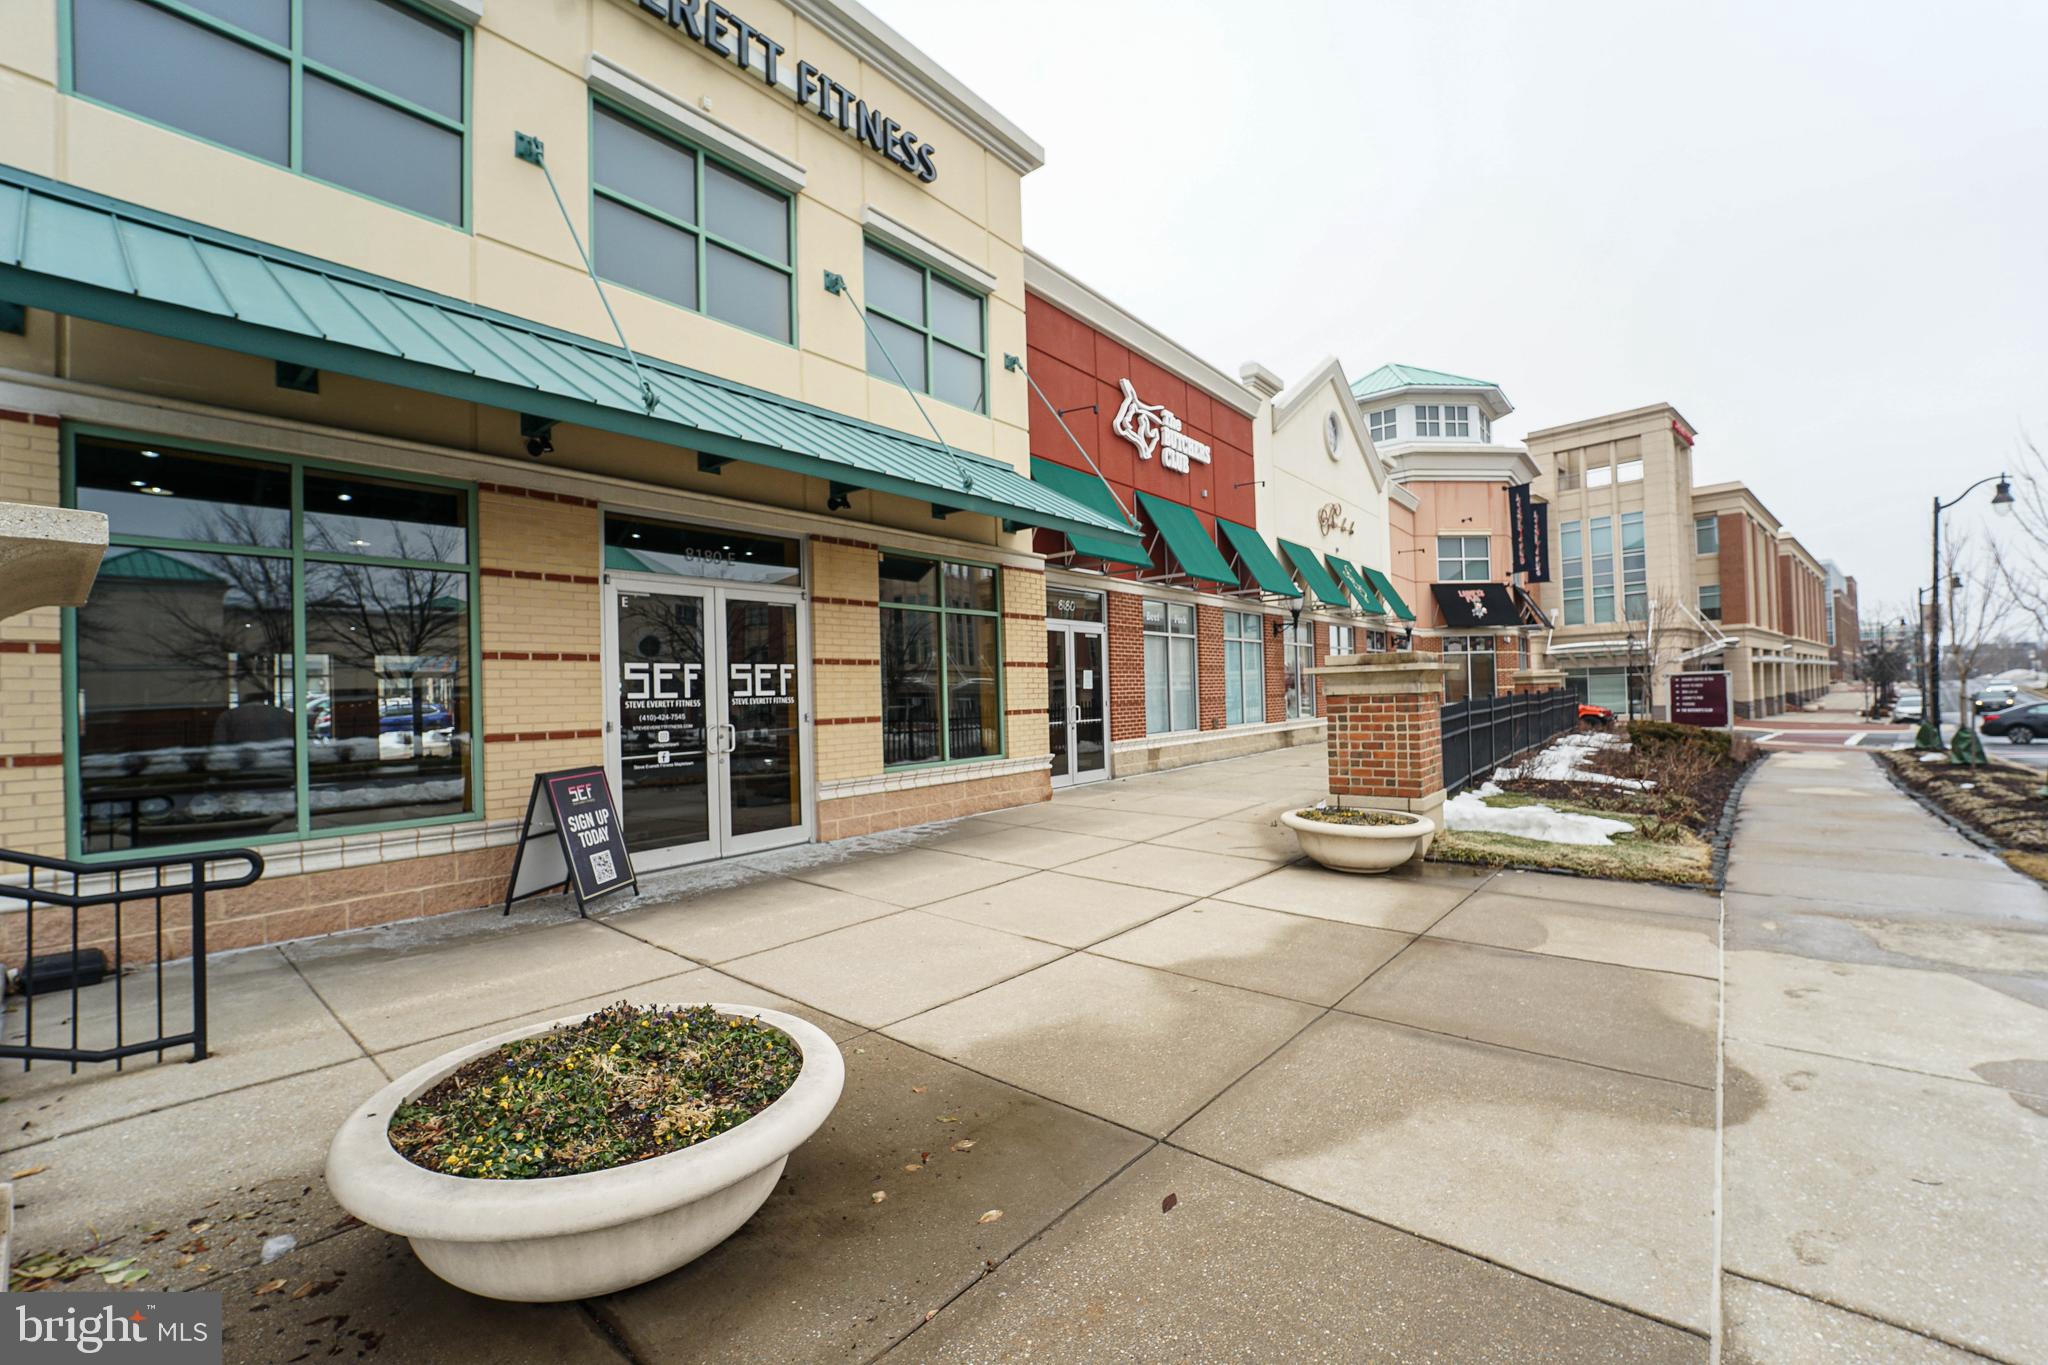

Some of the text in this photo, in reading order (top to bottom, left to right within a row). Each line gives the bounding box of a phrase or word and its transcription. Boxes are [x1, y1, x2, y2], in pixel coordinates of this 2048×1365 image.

[797, 60, 938, 183] FITNESS
[621, 596, 629, 608] E
[624, 662, 702, 699] SEF
[731, 663, 795, 697] SEF
[624, 699, 701, 709] STEVE EVERETT FITNESS
[731, 696, 795, 706] STEVE EVERETT FITNESS
[568, 783, 592, 803] SEF
[568, 808, 610, 832] SIGN UP
[577, 825, 610, 848] TODAY
